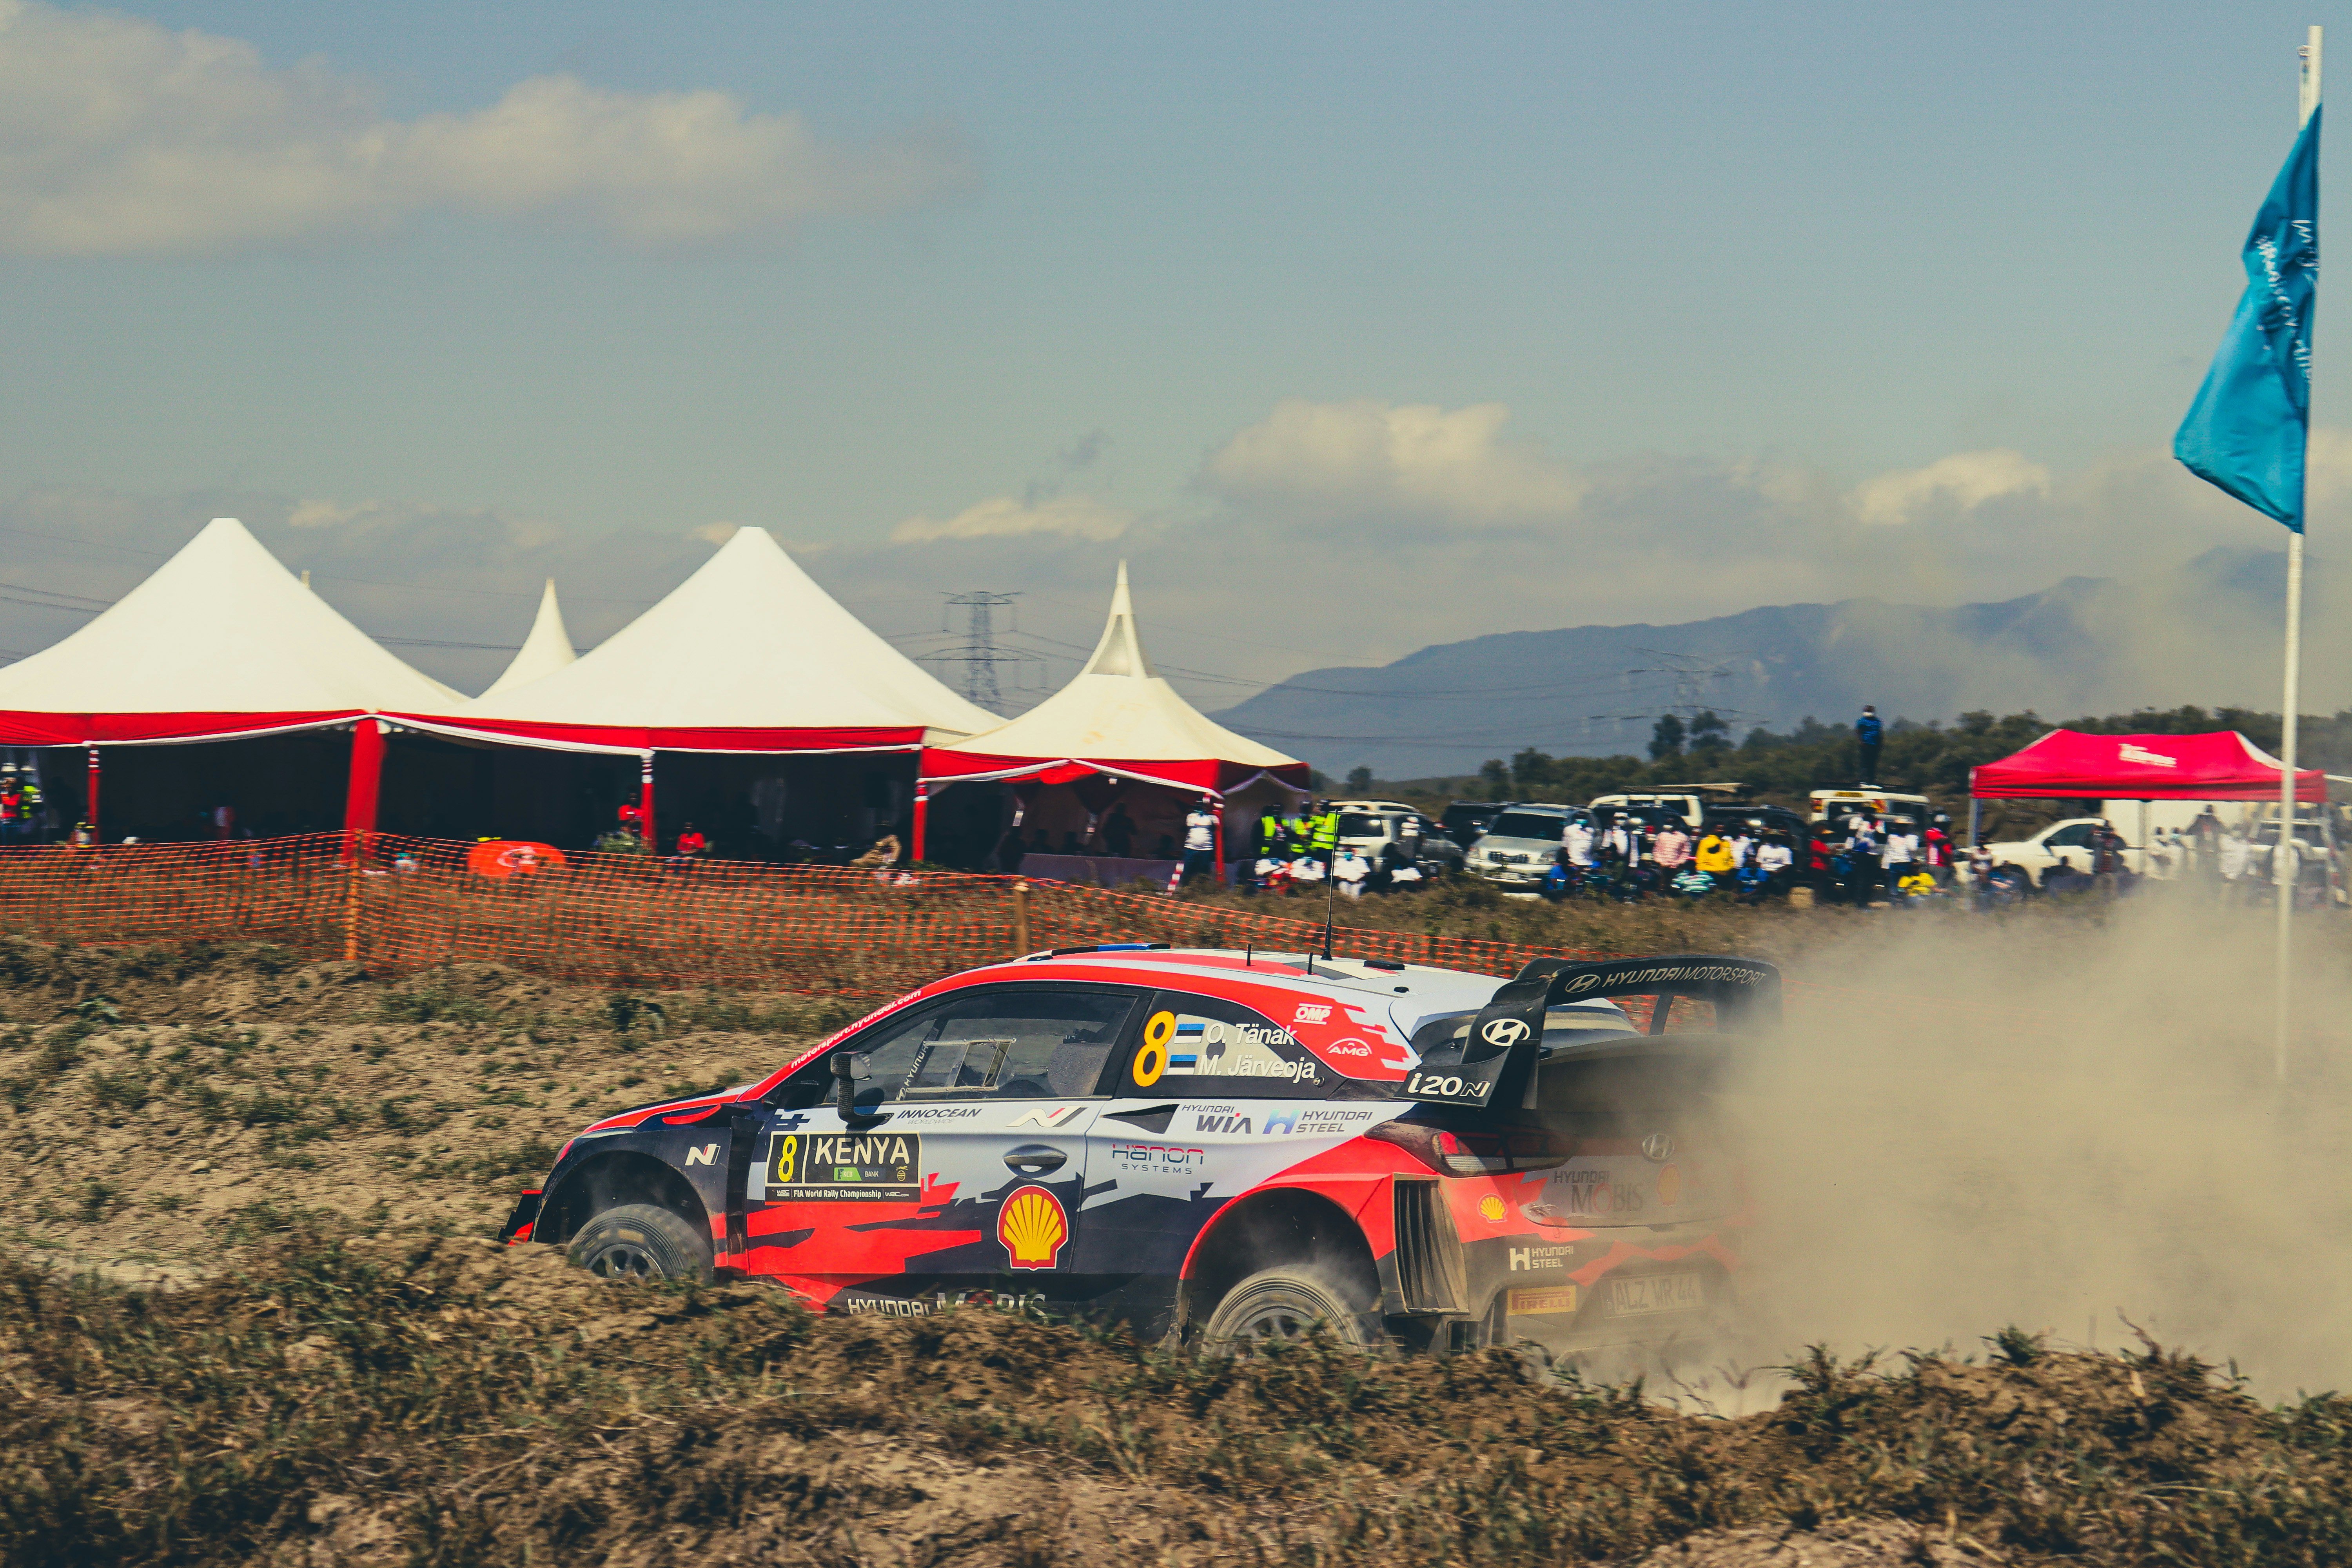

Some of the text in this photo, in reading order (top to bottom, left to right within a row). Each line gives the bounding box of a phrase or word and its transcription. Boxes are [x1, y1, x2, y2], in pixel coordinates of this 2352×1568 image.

[1296, 1007, 1330, 1021] OMP
[791, 990, 922, 1069] motorsport.hyundai.com
[1206, 1023, 1298, 1045] O. Tänak
[1132, 1011, 1175, 1087] 8
[1328, 1045, 1369, 1056] AMG
[904, 1042, 929, 1087] HYUNDA
[1198, 1054, 1316, 1083] M. Järveoja
[897, 1108, 982, 1119] INNOCEAN
[1181, 1104, 1235, 1113] HYUNDAI
[1196, 1112, 1252, 1134] WIA
[1301, 1111, 1373, 1121] HYUNDAI
[1296, 1123, 1345, 1133] STEEL
[815, 1137, 910, 1164] KENYA
[778, 1135, 797, 1182] 8
[1122, 1163, 1192, 1174] SYSTEMS
[1553, 1170, 1610, 1183] HYUNDAI
[824, 1189, 839, 1199] Rally
[840, 1189, 882, 1199] Championship
[1571, 1183, 1644, 1214] MOBIS
[1532, 1246, 1574, 1257] HYUNDAI
[1532, 1258, 1563, 1269] STEEL
[1512, 1290, 1571, 1310] PIRELLI
